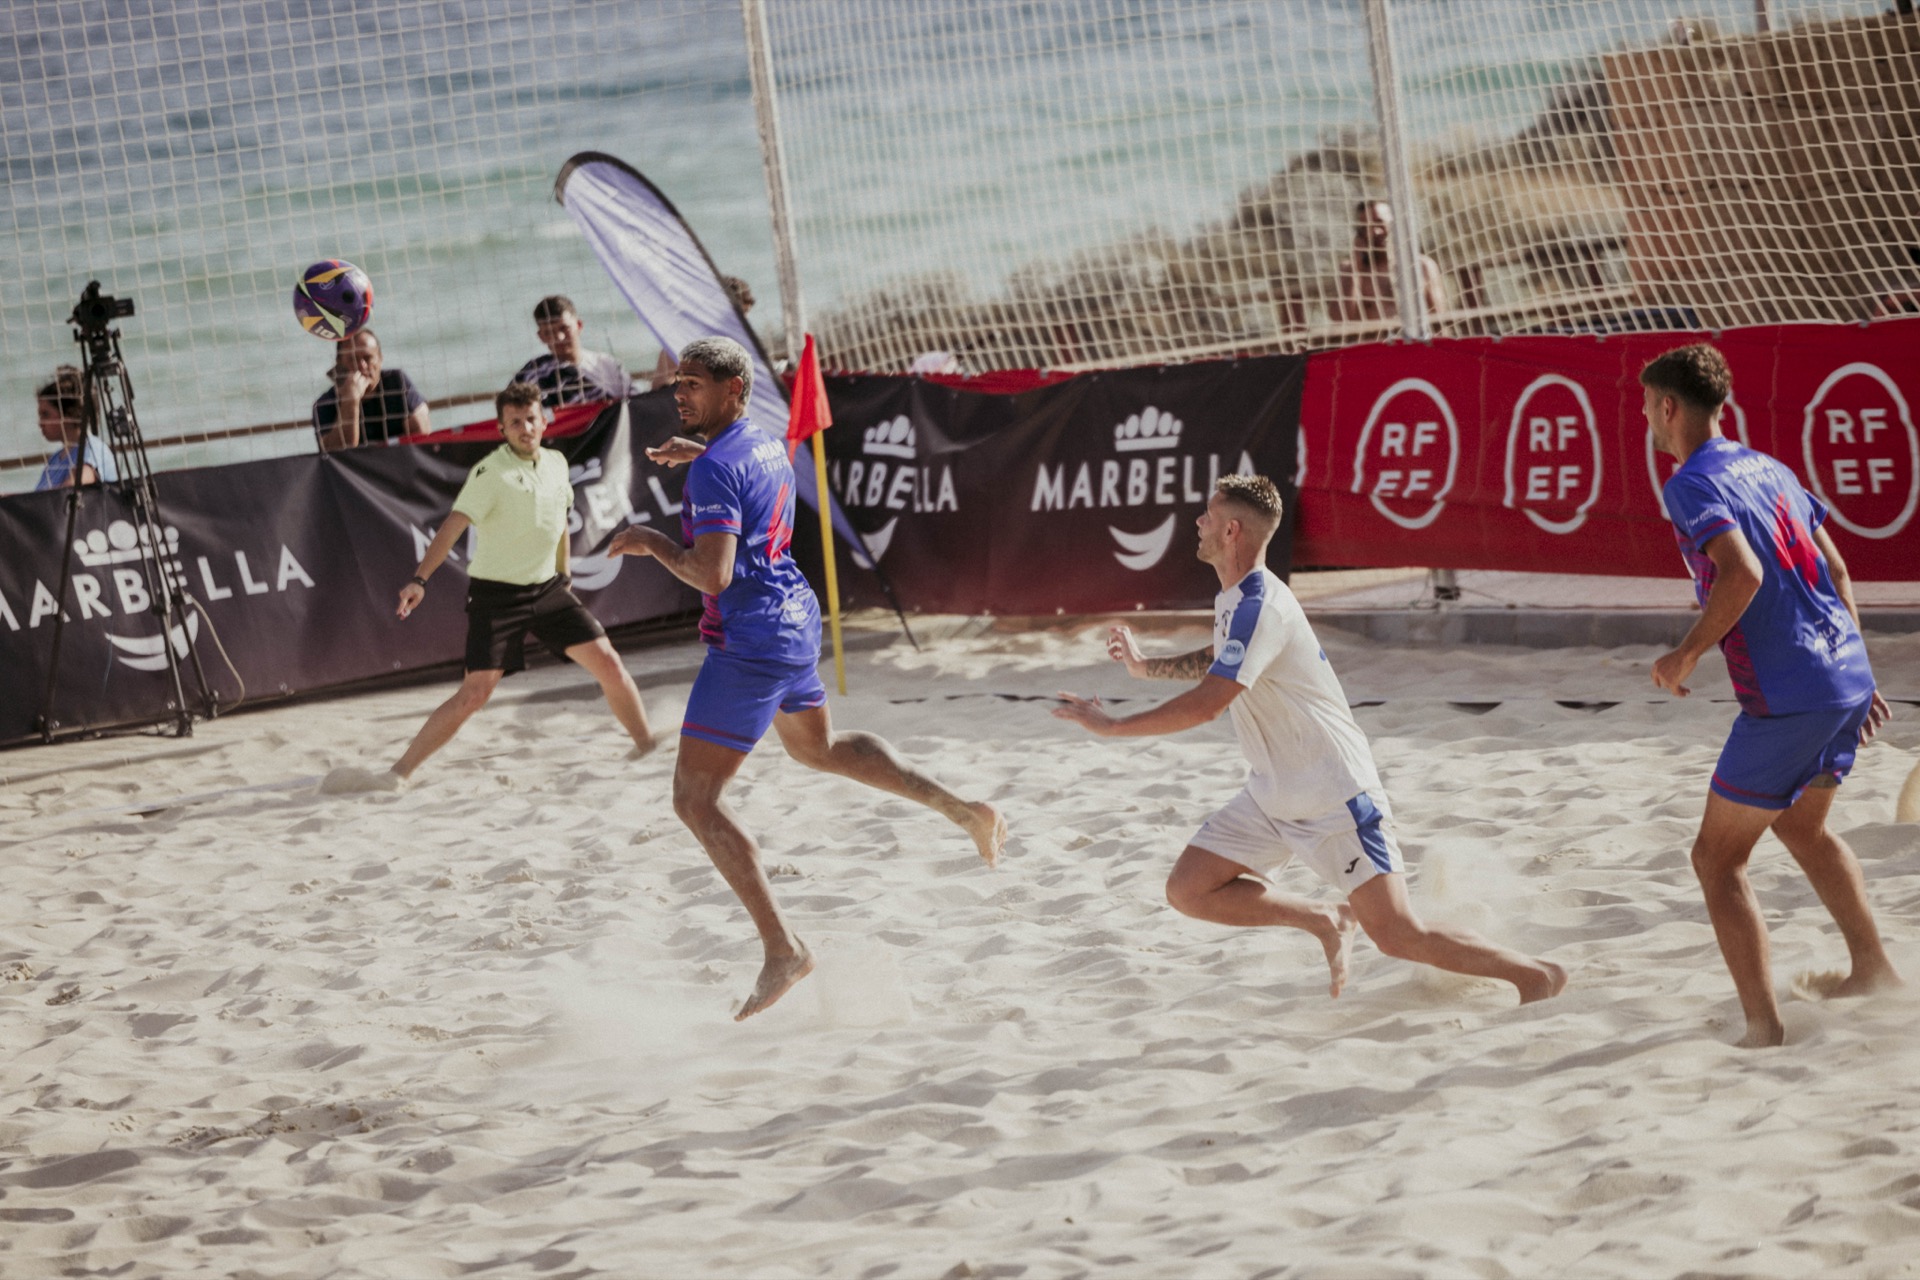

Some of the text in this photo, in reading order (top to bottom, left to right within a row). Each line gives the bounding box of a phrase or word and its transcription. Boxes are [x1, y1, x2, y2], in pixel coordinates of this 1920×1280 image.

[1381, 421, 1439, 456] RF
[1530, 416, 1578, 451] RF
[1825, 408, 1888, 444] RF
[1372, 469, 1433, 499] EF
[1526, 465, 1582, 500] EF
[1832, 458, 1895, 495] EF
